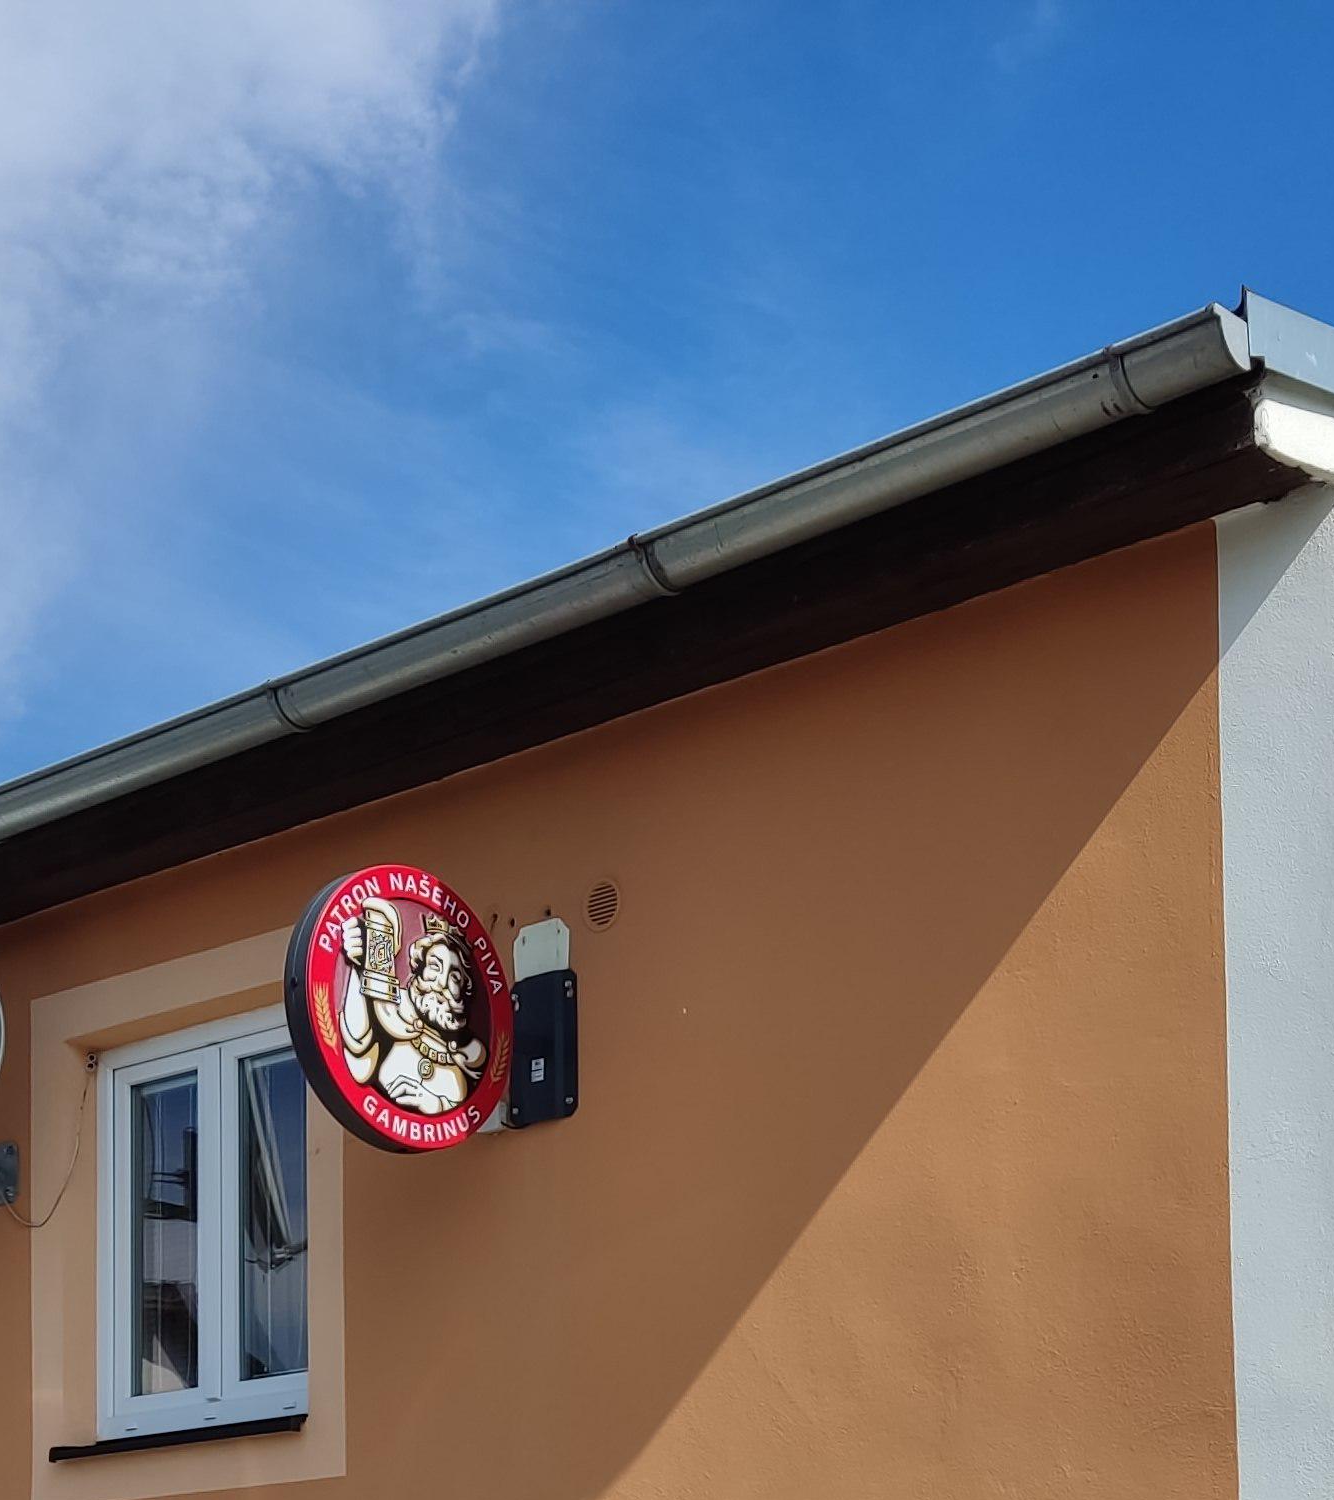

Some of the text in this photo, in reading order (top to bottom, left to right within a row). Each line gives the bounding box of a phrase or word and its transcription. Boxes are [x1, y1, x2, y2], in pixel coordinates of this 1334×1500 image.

[317, 872, 504, 996] PATRON NAŠEHO PIVA
[362, 1095, 482, 1143] GAMBRINUS
